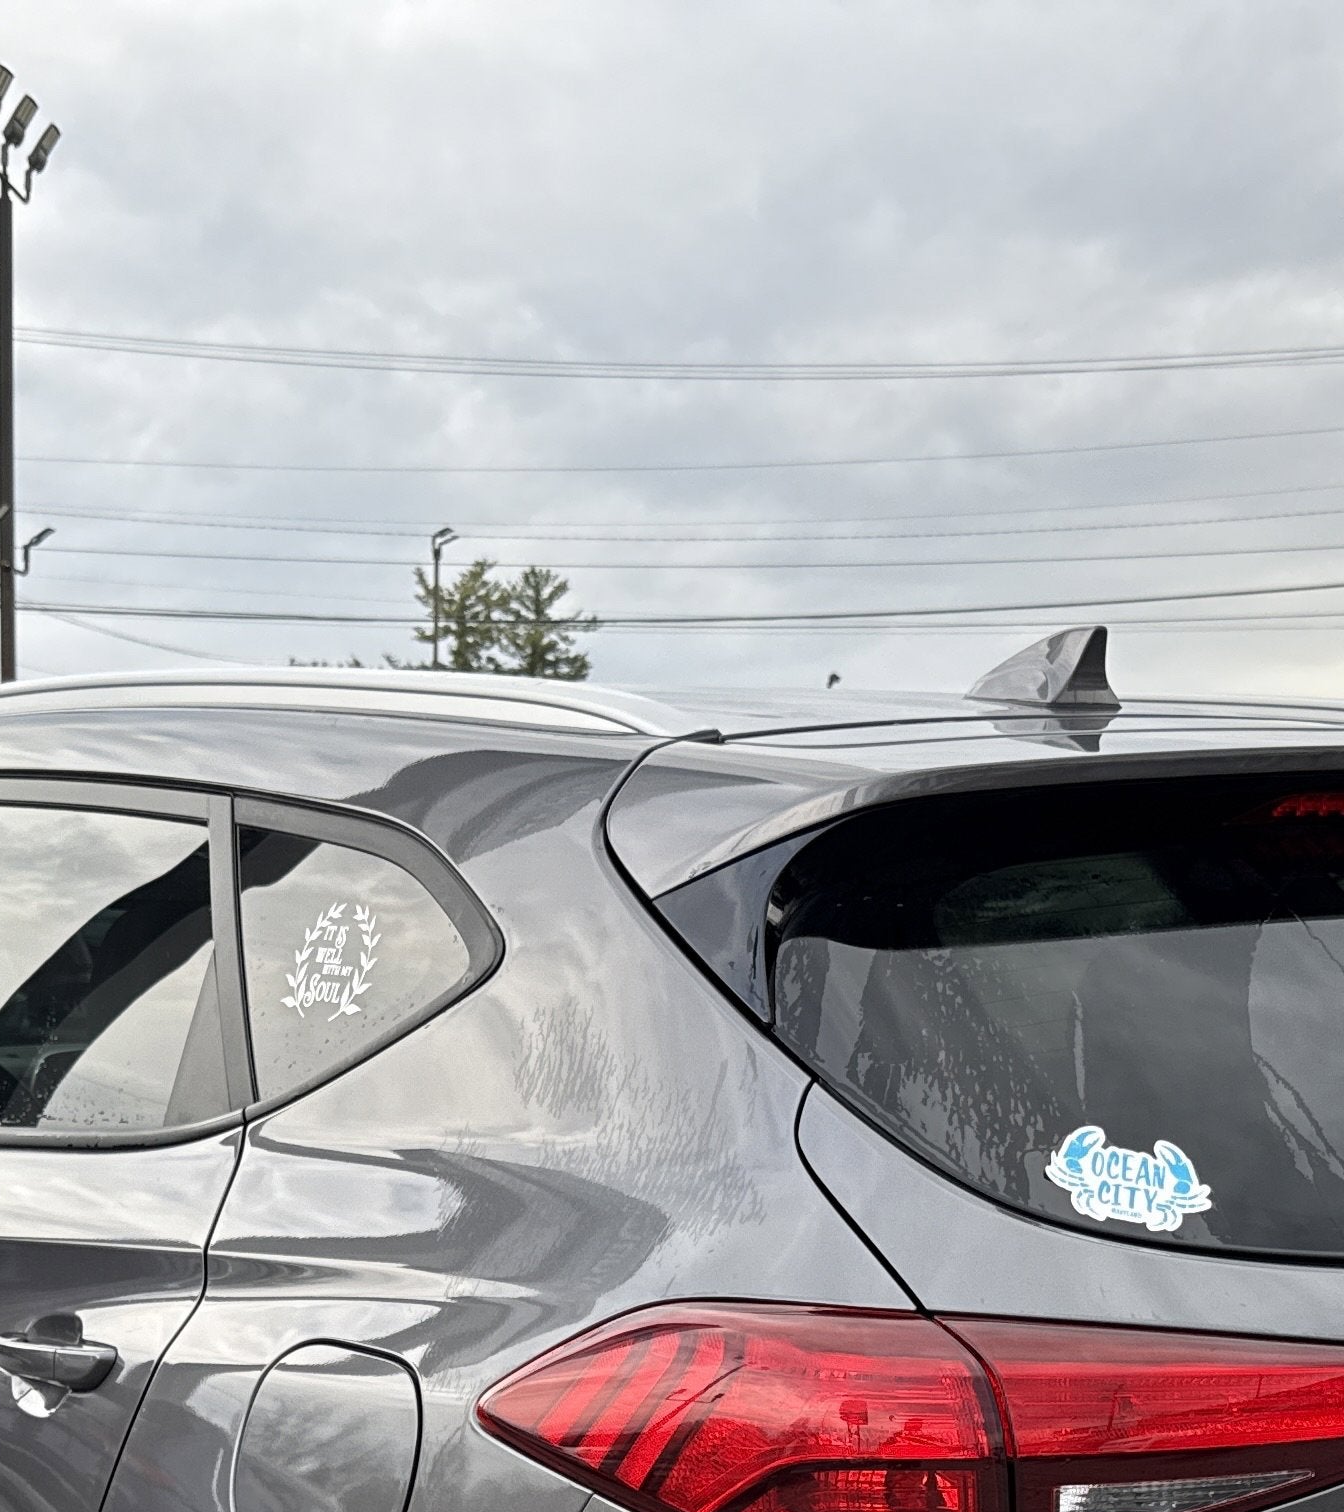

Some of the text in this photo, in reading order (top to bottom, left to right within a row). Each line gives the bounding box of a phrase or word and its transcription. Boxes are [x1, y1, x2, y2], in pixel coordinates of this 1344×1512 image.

[323, 925, 337, 941] IT
[315, 946, 343, 965] WELL
[321, 964, 354, 977] WITH MY
[1091, 1151, 1166, 1189] OCEAN
[1097, 1180, 1158, 1213] CITY
